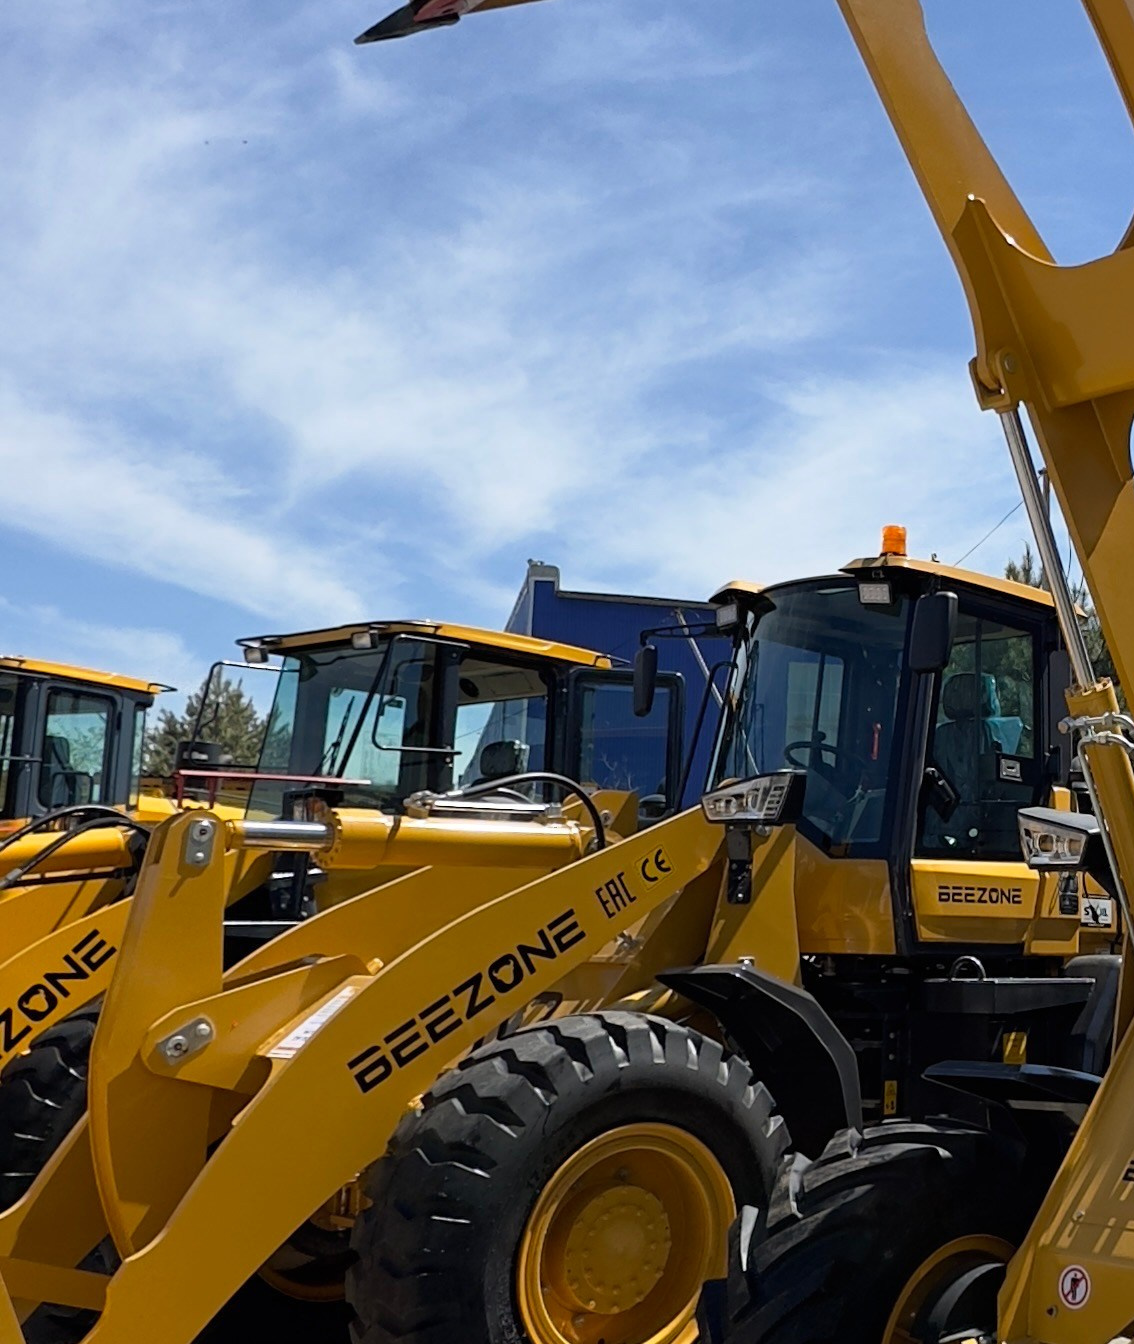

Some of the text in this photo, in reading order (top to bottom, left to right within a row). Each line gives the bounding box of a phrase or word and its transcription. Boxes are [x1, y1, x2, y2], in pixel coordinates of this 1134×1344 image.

[937, 885, 1023, 905] BEEZONE
[0, 929, 118, 1060] ZONE
[347, 909, 587, 1094] BEEZONE
[595, 871, 637, 919] EAC
[641, 848, 672, 882] CE
